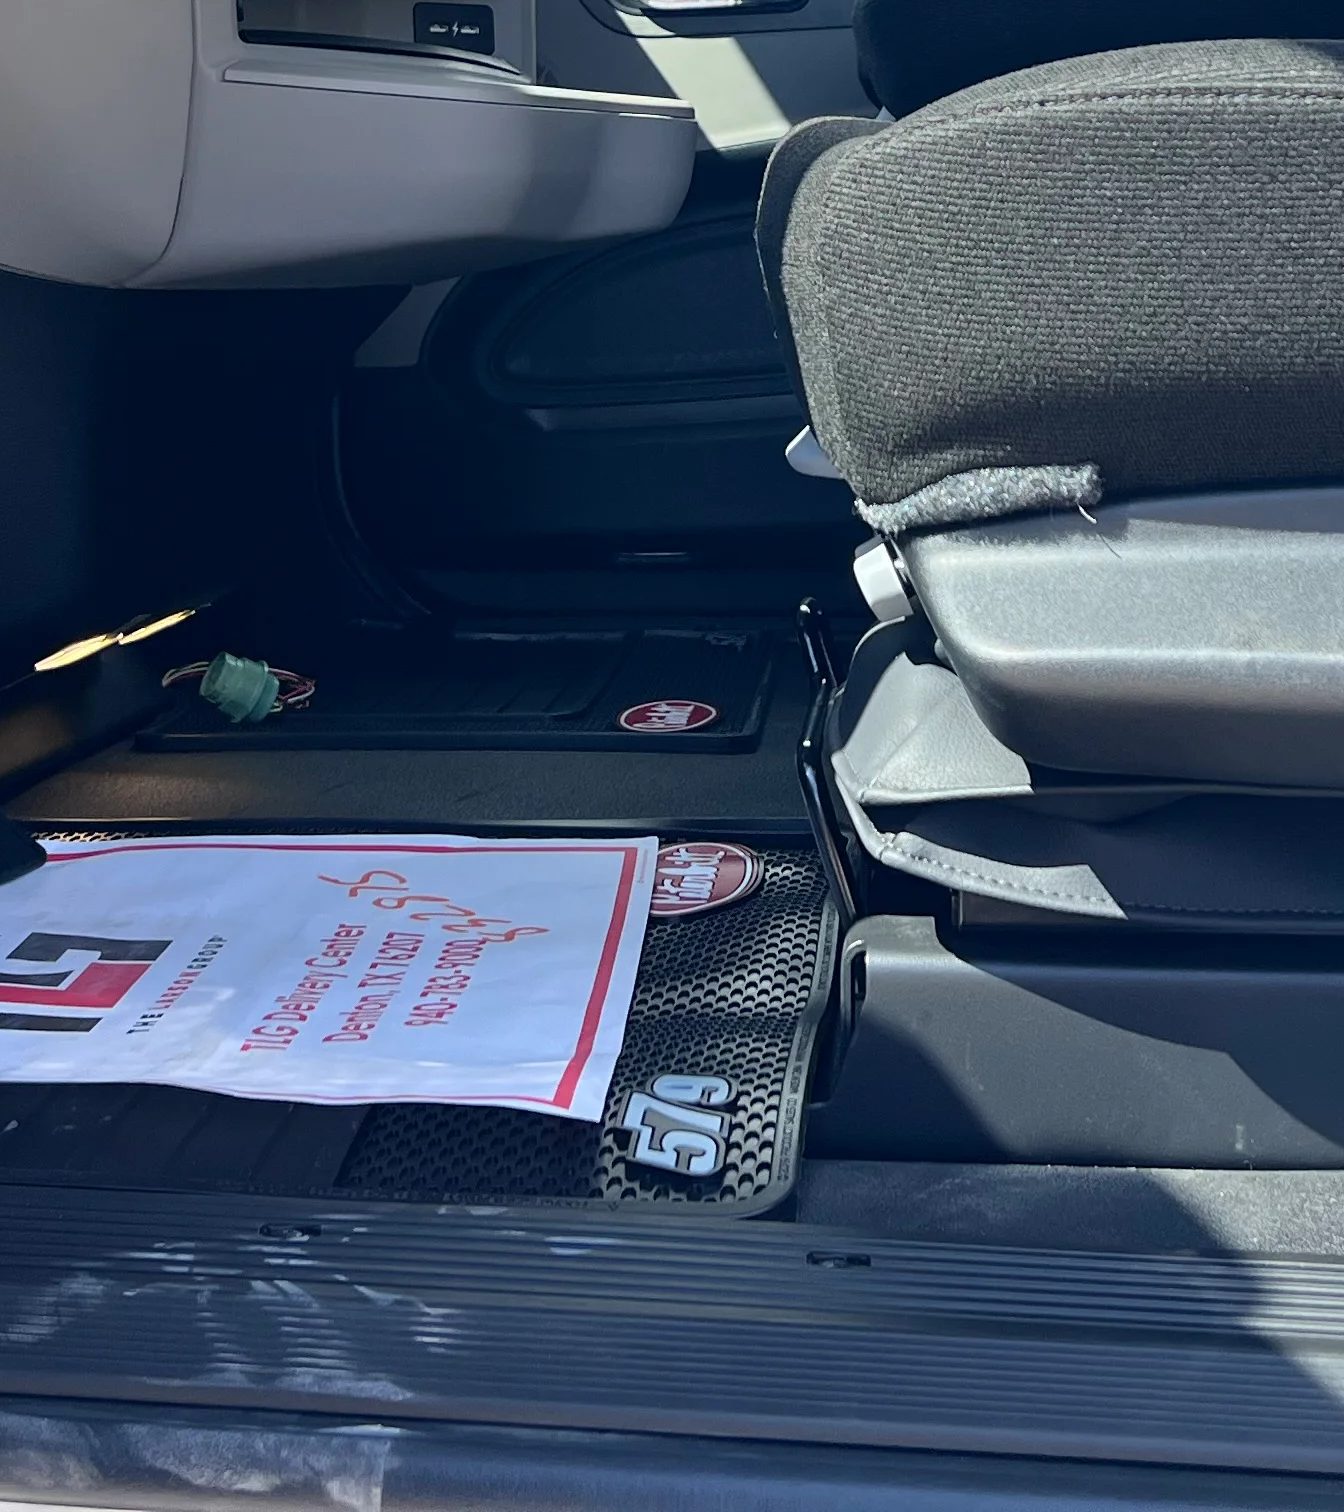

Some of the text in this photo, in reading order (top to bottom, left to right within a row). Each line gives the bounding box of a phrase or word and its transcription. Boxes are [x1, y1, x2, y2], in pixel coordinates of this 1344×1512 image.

[126, 934, 227, 1035] THE LARSON GROUP
[240, 923, 367, 1052] TLG Delivery Center
[322, 932, 425, 1043] Denton, TX 76207
[404, 937, 488, 1027] 940-783-9000
[620, 1072, 732, 1175] 579
